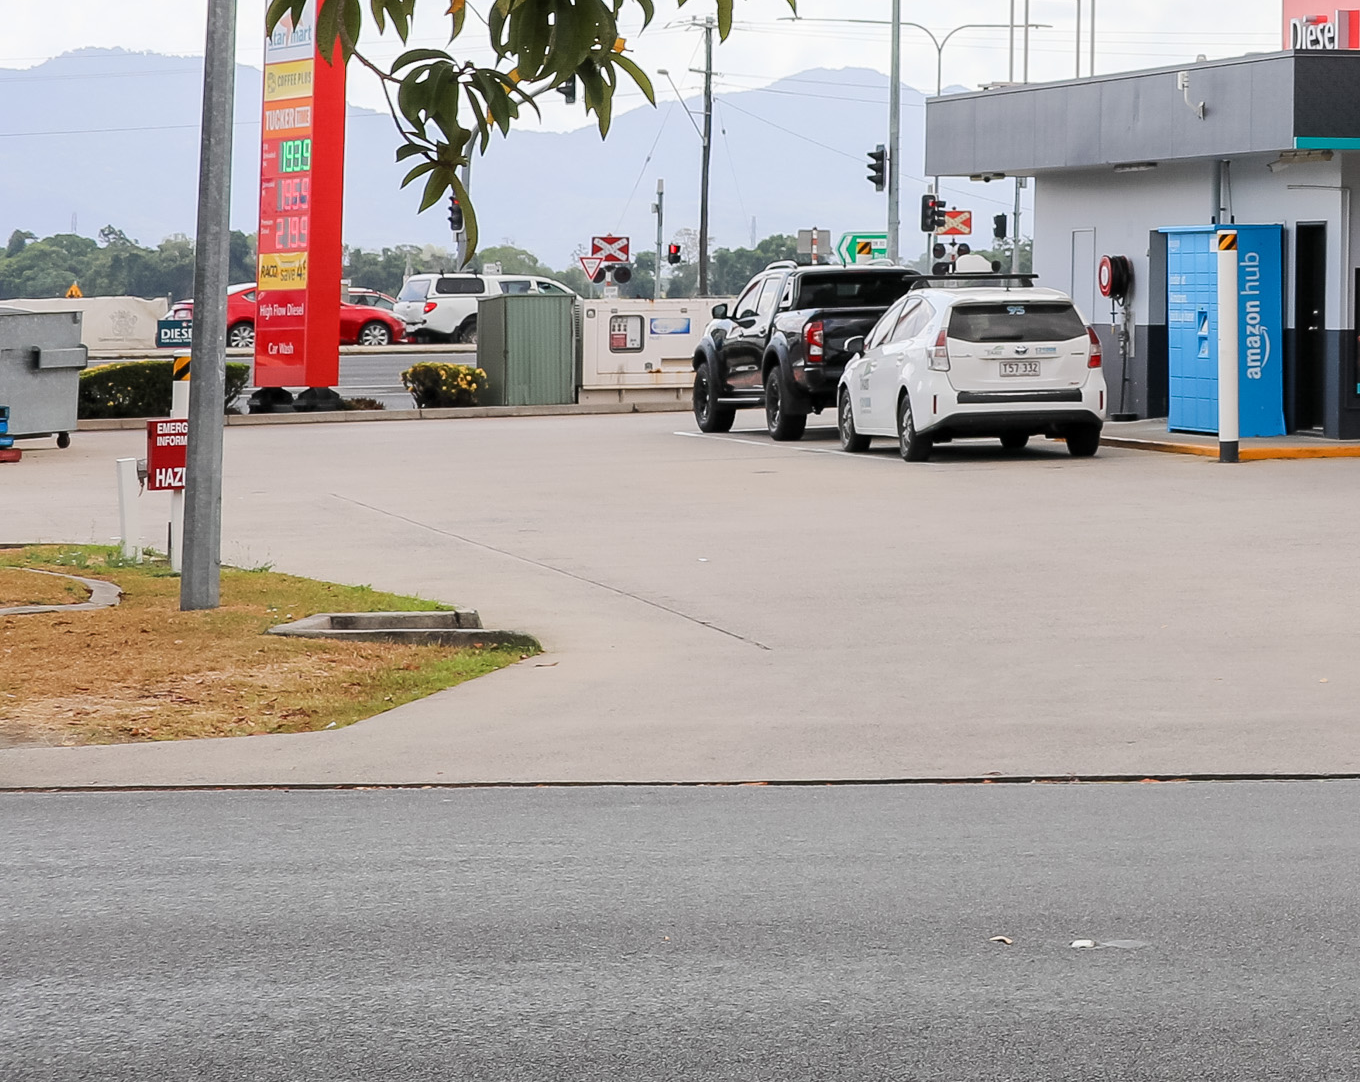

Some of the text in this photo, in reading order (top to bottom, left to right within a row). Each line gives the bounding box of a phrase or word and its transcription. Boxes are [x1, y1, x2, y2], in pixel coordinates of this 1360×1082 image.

[1289, 9, 1339, 49] Diesel
[277, 70, 312, 87] COFFEE PLUS
[265, 107, 296, 131] TUCKER
[259, 302, 305, 320] High Flow Diesel
[1007, 306, 1025, 316] 95
[1240, 251, 1262, 379] amazon hub
[267, 341, 294, 355] Car Wash
[1002, 362, 1038, 373] T57 332
[156, 422, 188, 435] EMERG
